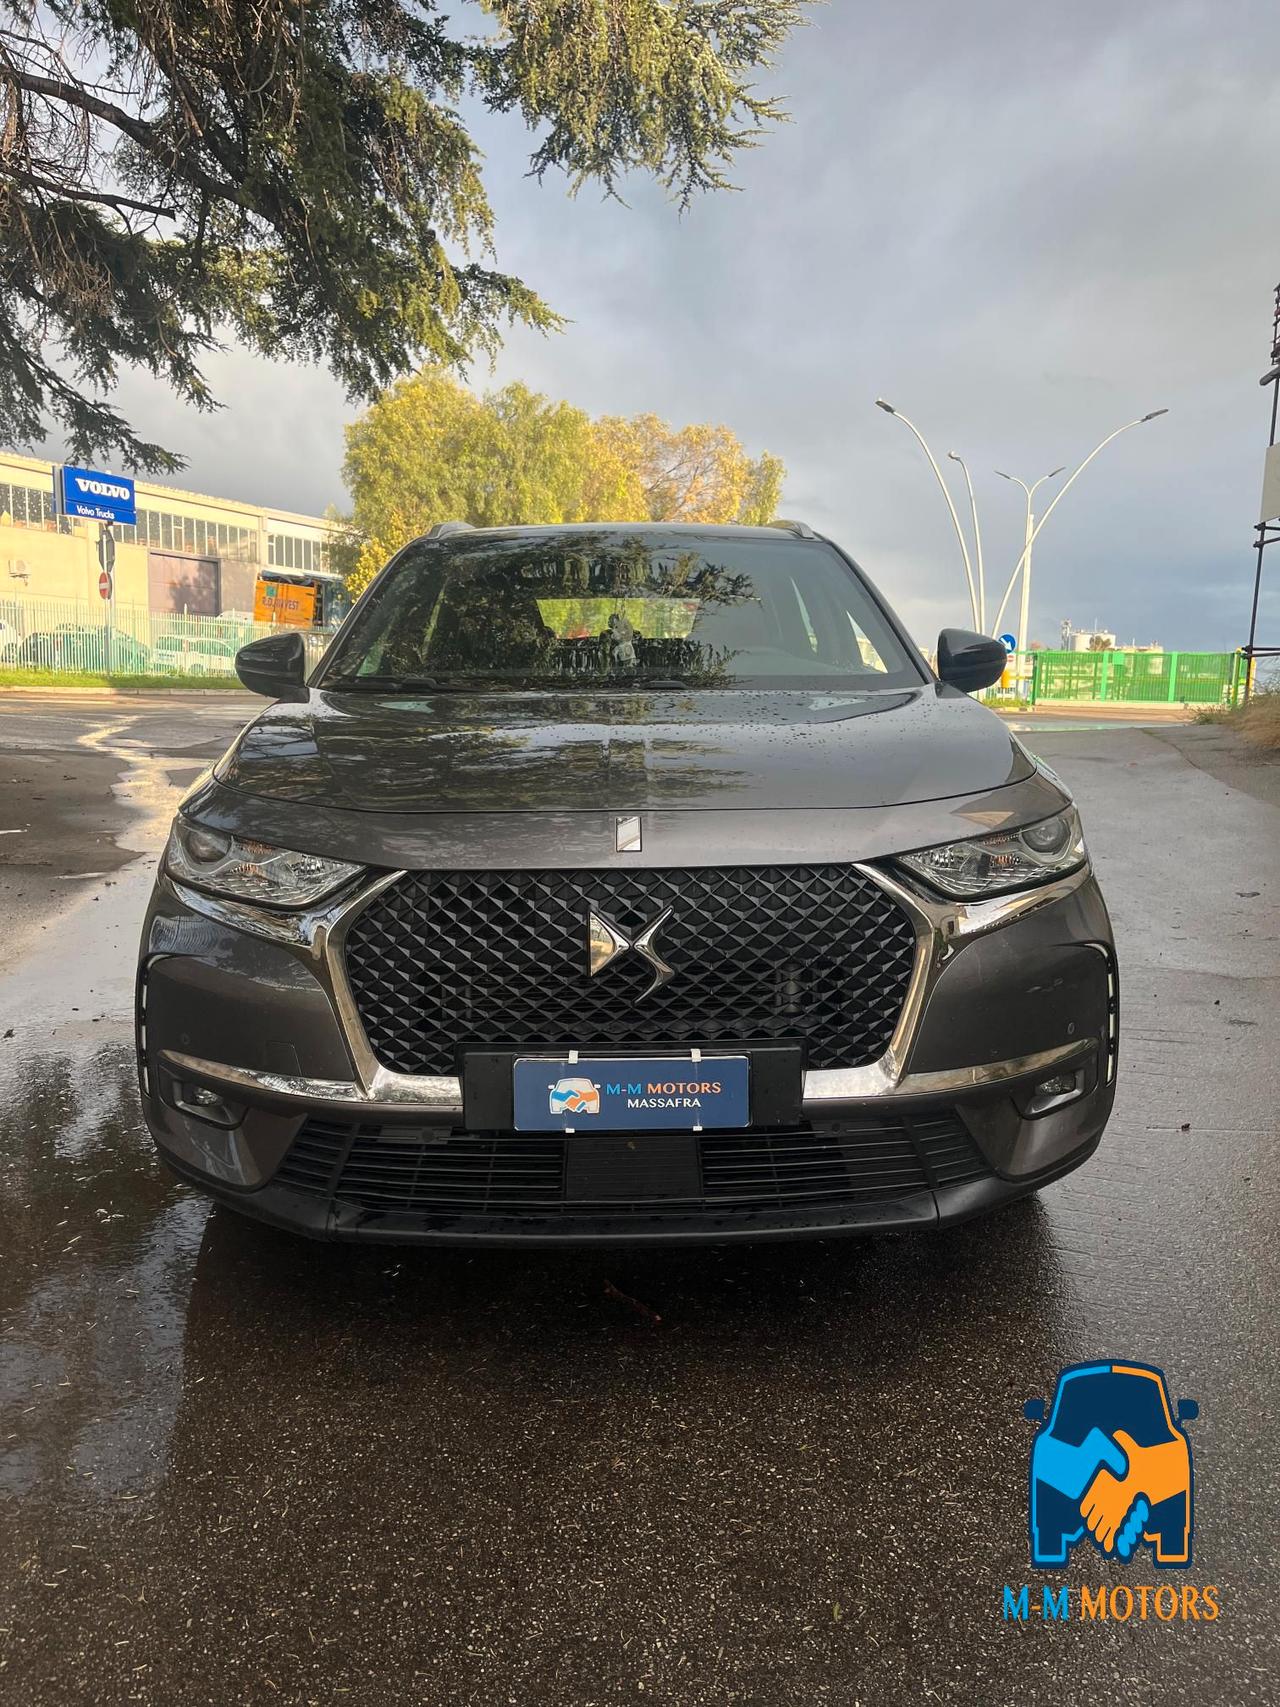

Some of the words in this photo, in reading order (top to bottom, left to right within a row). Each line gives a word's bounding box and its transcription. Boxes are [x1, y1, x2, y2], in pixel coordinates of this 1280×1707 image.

[75, 478, 130, 500] VOLVO
[76, 505, 95, 517] Volvo
[95, 507, 115, 520] Trucks
[606, 1083, 642, 1095] M-M
[647, 1082, 722, 1094] MOTORS
[627, 1098, 702, 1109] MASSAFRA
